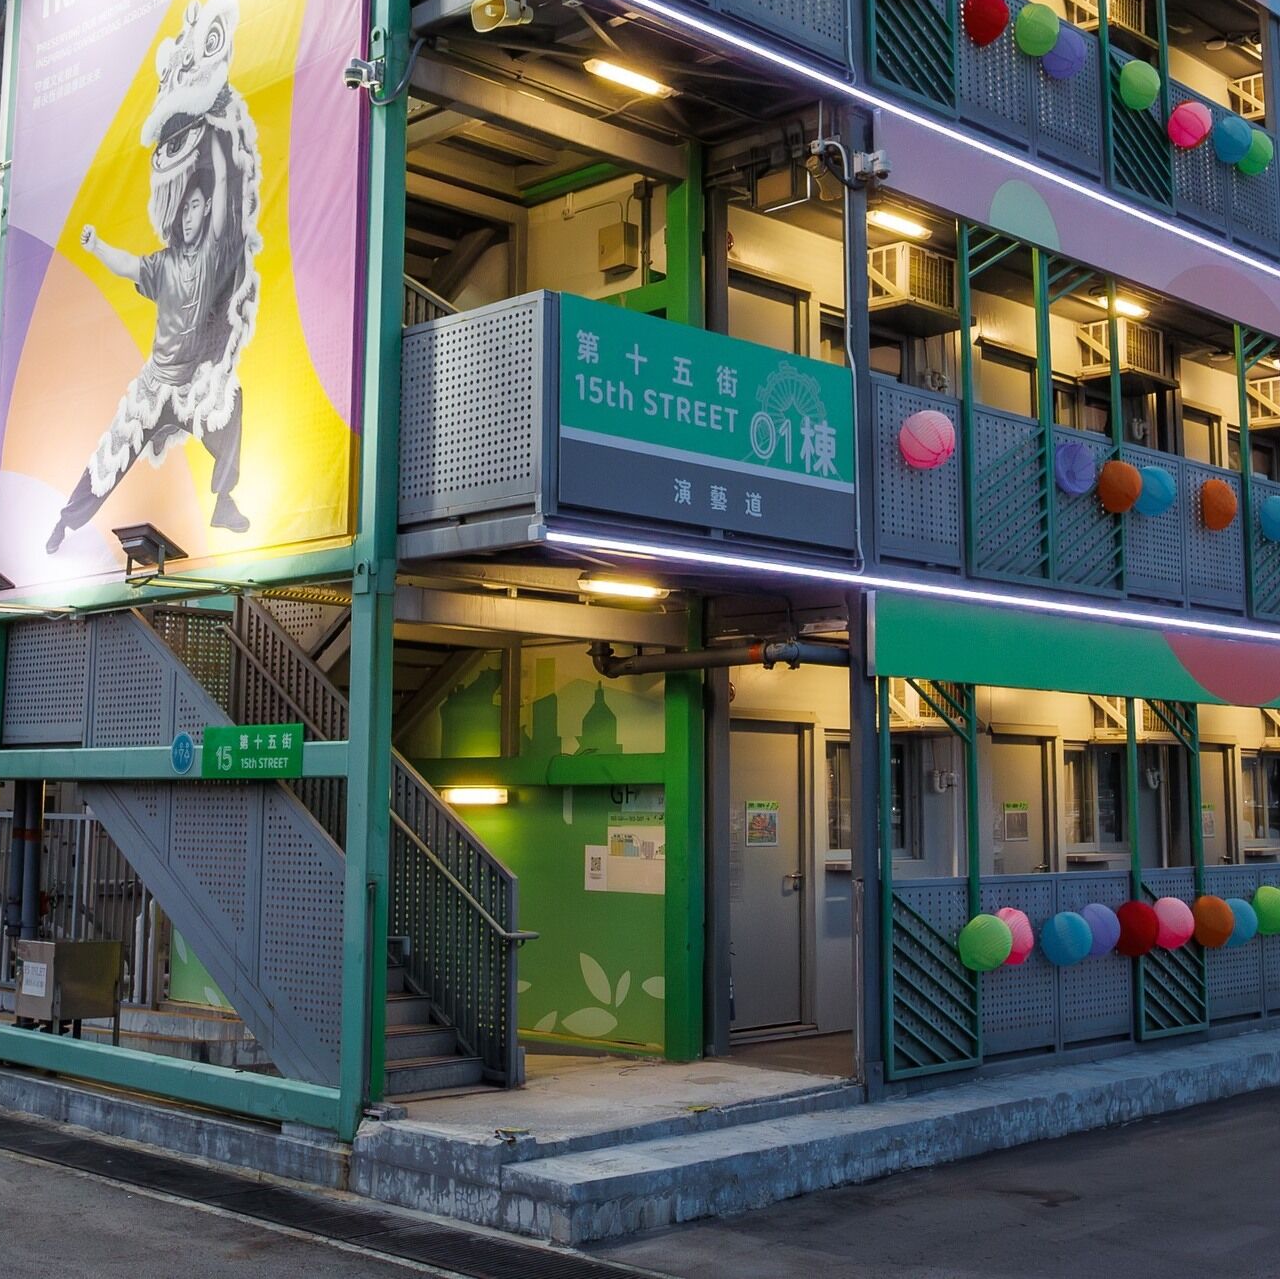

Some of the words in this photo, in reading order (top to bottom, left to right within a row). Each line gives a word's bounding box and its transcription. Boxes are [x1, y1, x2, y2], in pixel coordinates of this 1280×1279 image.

[576, 329, 738, 398] 第十五街
[575, 373, 634, 412] 15th
[643, 389, 739, 433] STREET
[749, 411, 837, 477] 01棟
[673, 478, 763, 518] 演藝道
[216, 745, 233, 771] 15
[239, 732, 292, 750] 第十五街
[240, 758, 257, 769] 15th
[259, 758, 288, 769] STREET
